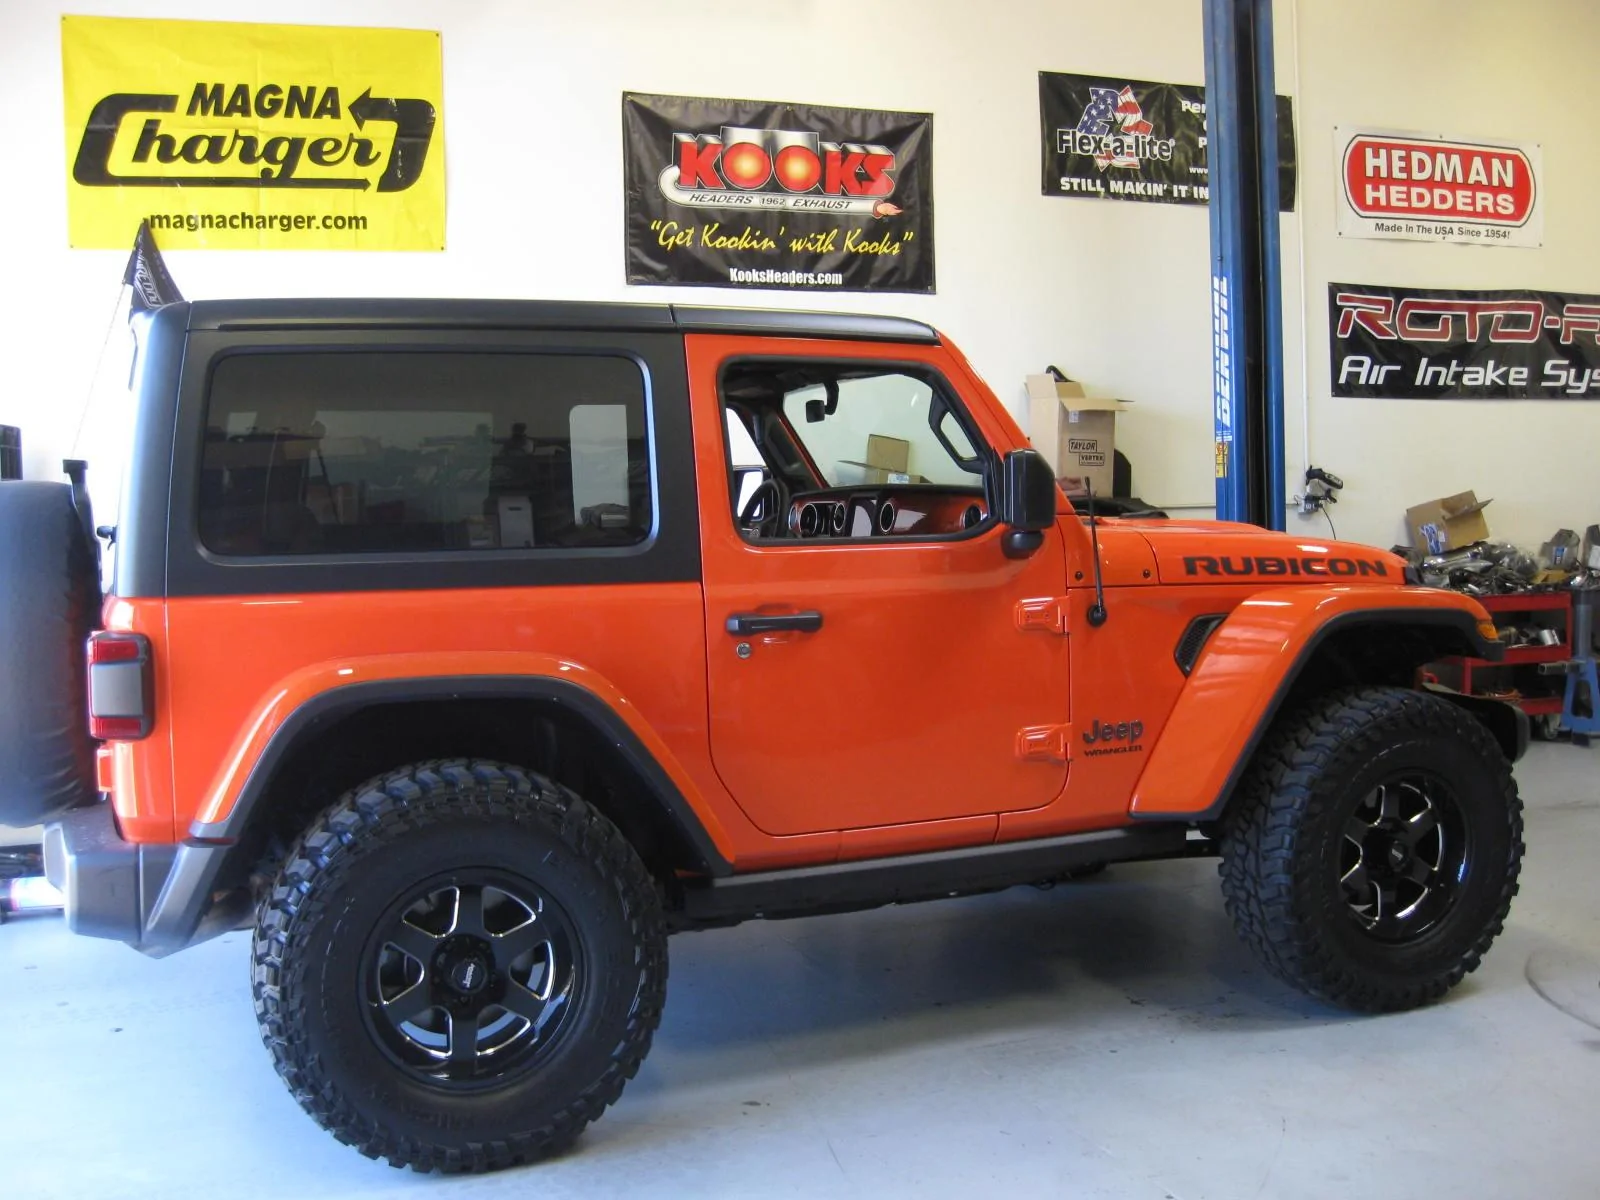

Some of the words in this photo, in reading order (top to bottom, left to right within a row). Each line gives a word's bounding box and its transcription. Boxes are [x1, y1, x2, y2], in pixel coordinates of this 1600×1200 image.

[186, 82, 342, 120] MAGNA
[1181, 100, 1206, 115] Per
[73, 92, 383, 191] Charger
[1057, 129, 1173, 161] Flex-a-lite
[677, 130, 894, 197] KOOKS
[1365, 147, 1514, 188] HEDMAN
[1060, 177, 1105, 192] STILL
[1110, 180, 1167, 197] MAKIN'
[1172, 184, 1188, 198] IT
[1365, 184, 1515, 215] HEDDERS
[689, 193, 754, 205] HEADERS
[760, 196, 786, 207] 1962
[793, 198, 852, 210] EXHAUST
[149, 212, 368, 232] magnacharger.com
[1374, 222, 1403, 233] Made
[1405, 224, 1414, 233] In
[1416, 225, 1432, 235] The
[1435, 225, 1454, 236] USA
[1457, 227, 1482, 237] Since
[1484, 228, 1510, 239] 1954!
[701, 222, 784, 250] Kookin'
[789, 229, 840, 252] with
[729, 267, 843, 285] KooksHeaders.com
[1336, 293, 1600, 345] ROTO-F
[1338, 356, 1401, 385] Air
[1414, 357, 1528, 386] Intake
[1541, 359, 1600, 394] Sys
[1070, 441, 1096, 450] TAYLOR
[1182, 556, 1387, 577] RUBICON
[1083, 719, 1143, 744] Jeep
